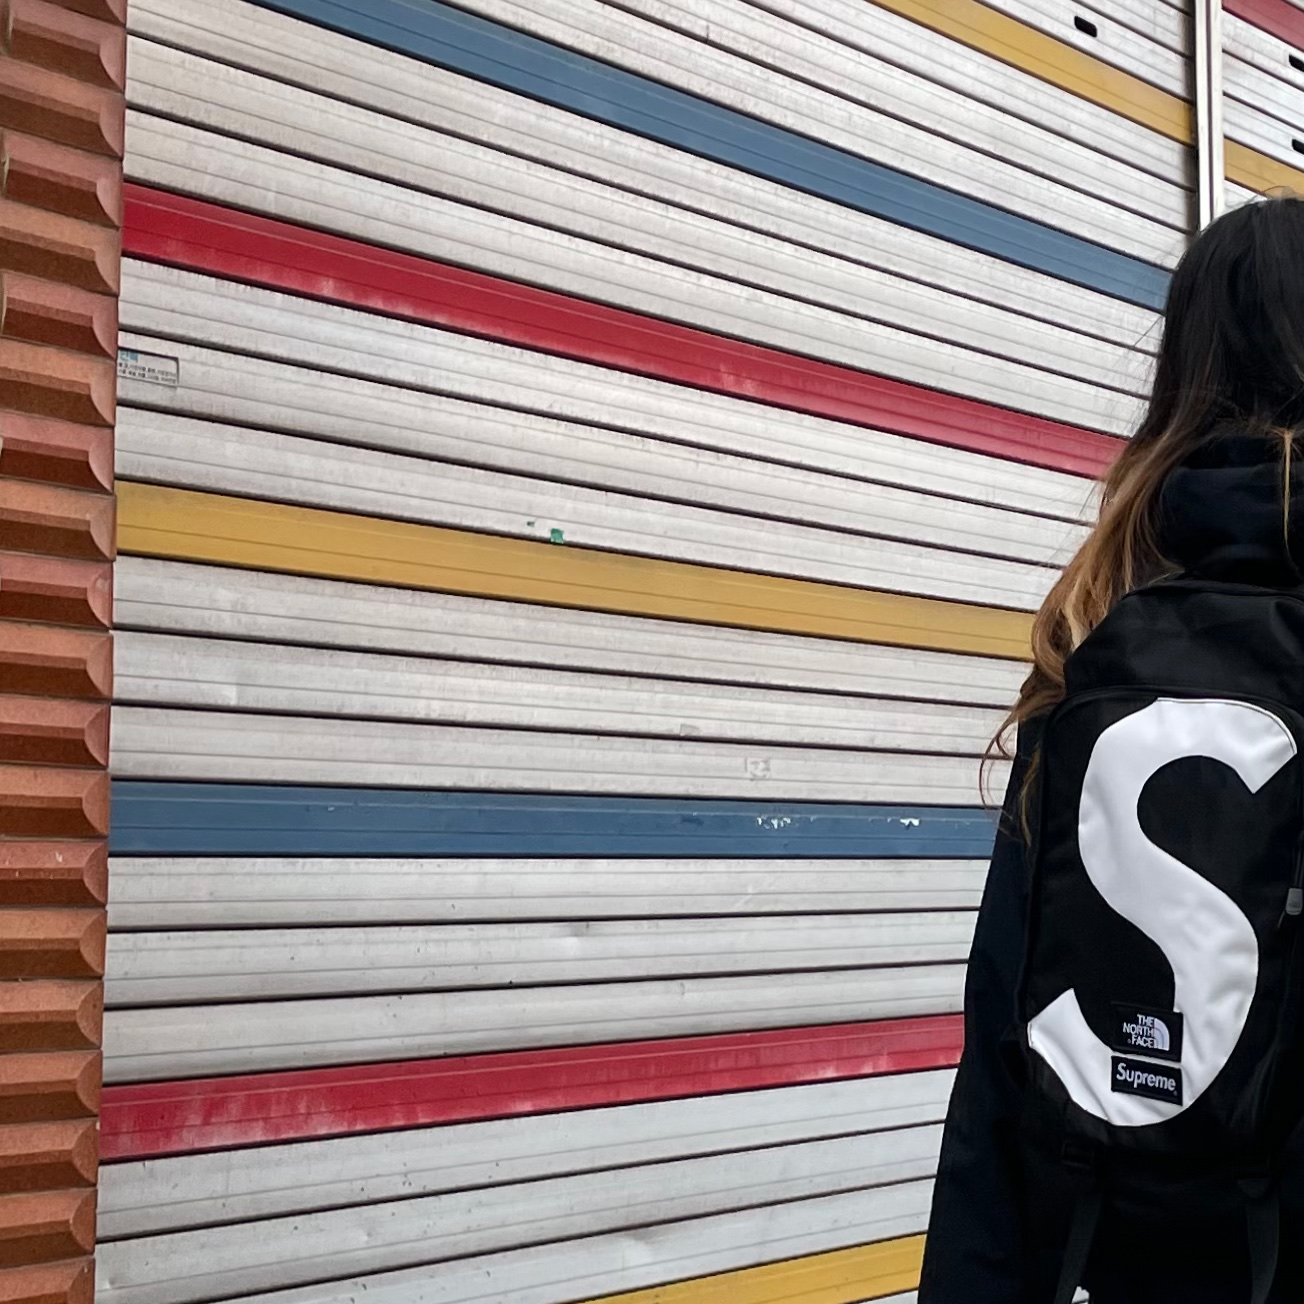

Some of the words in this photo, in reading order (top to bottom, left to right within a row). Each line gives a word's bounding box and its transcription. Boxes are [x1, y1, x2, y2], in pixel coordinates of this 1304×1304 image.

[1027, 697, 1298, 1127] S
[1137, 1013, 1154, 1028] THE
[1122, 1022, 1154, 1038] NORTH
[1131, 1034, 1154, 1049] FACE
[1116, 1062, 1177, 1092] Supreme
